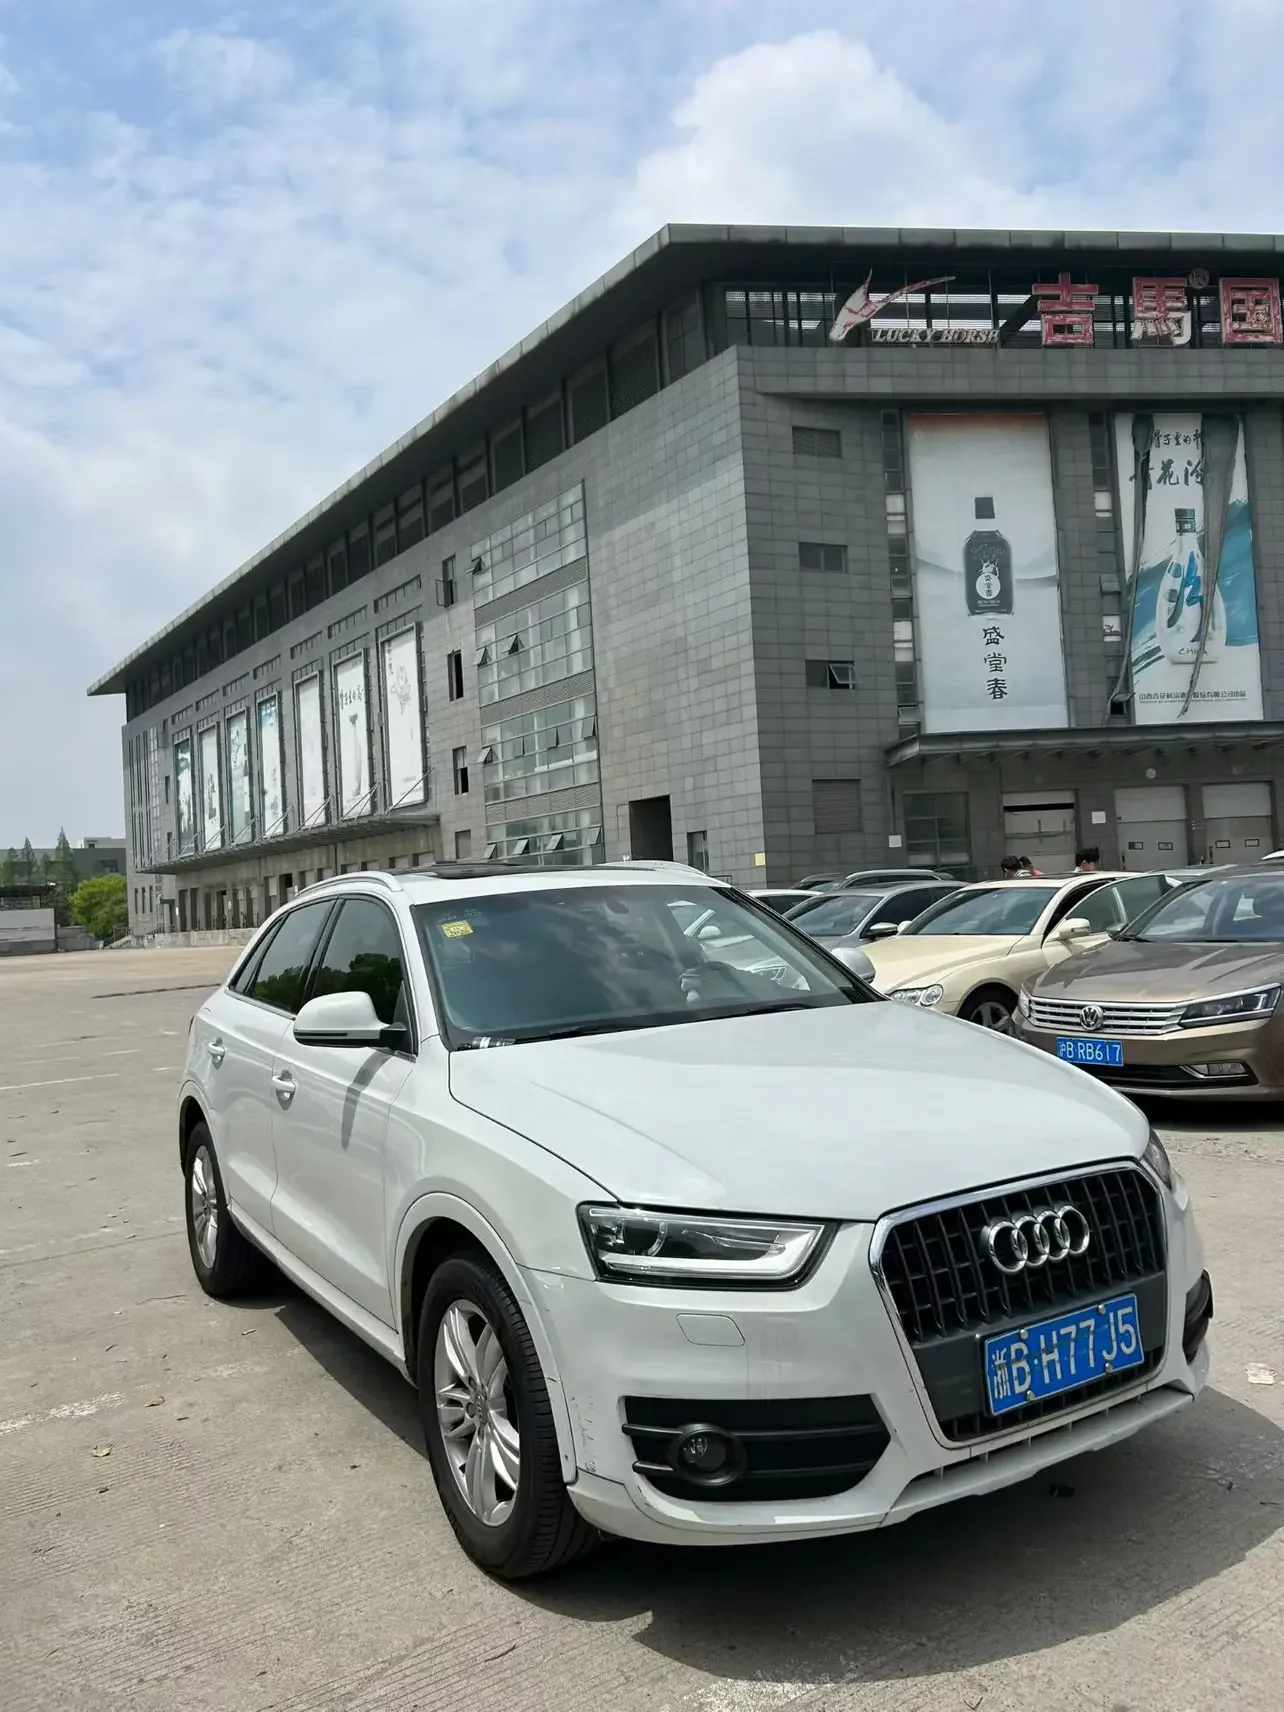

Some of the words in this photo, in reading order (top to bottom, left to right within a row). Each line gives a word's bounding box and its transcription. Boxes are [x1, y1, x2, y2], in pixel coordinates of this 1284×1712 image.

[873, 328, 936, 342] LUCKY
[938, 328, 1000, 343] HORSE
[982, 626, 1008, 700] 盛堂春
